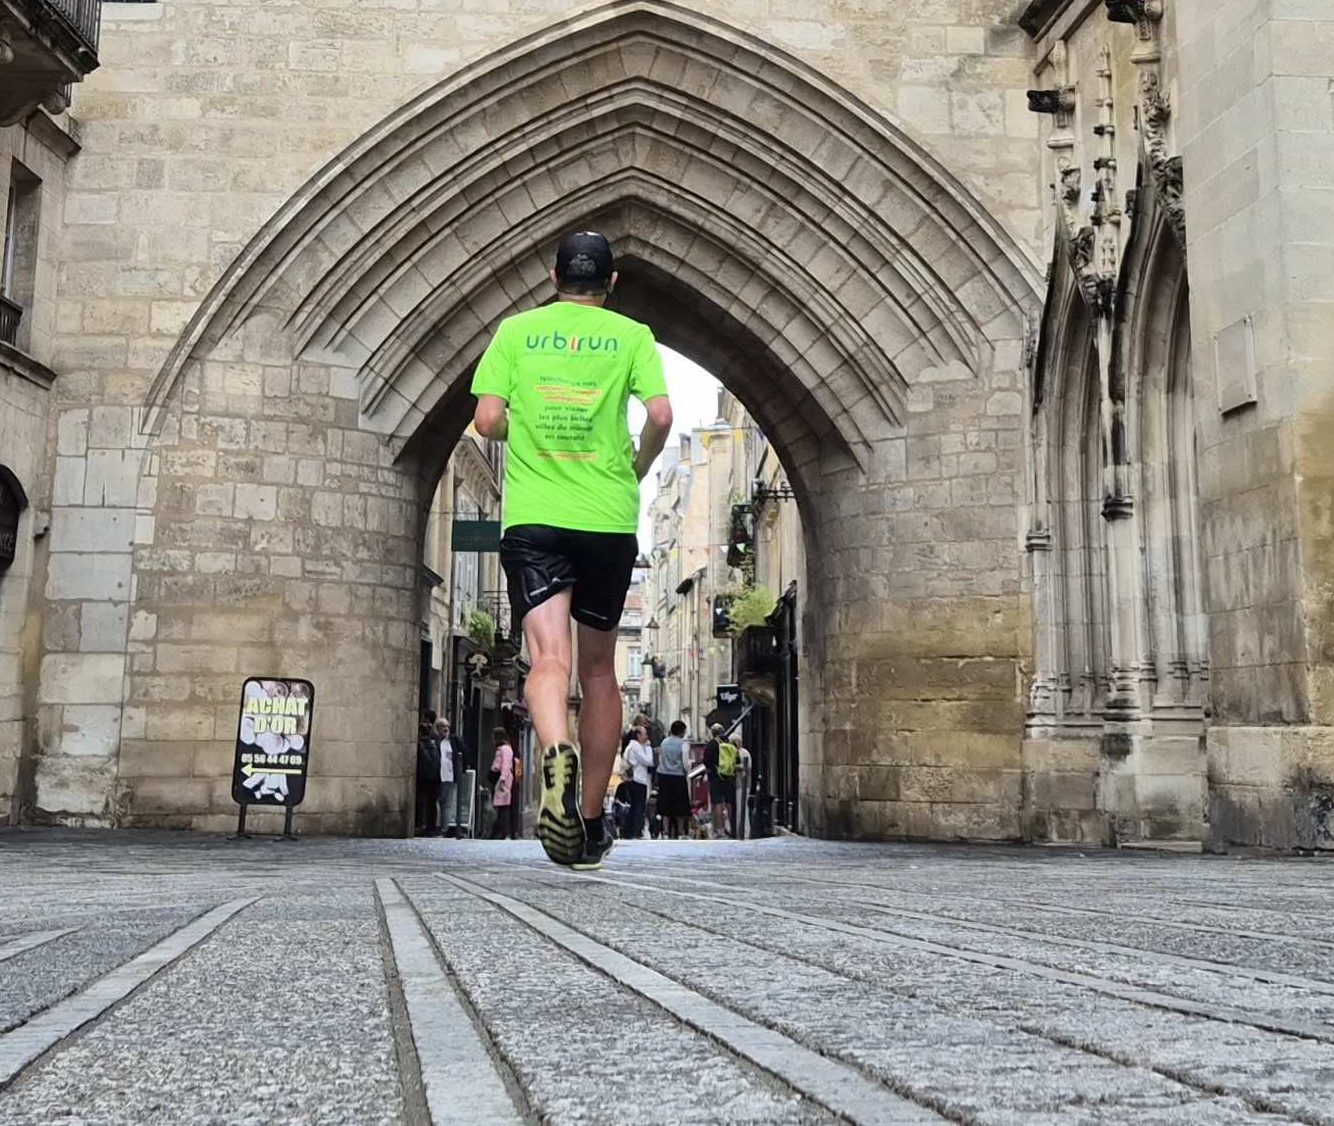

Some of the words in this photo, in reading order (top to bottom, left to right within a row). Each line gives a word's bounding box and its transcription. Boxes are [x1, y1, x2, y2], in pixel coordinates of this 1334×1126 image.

[526, 331, 618, 351] urbirun
[552, 414, 568, 422] plus
[248, 696, 309, 716] ACHAT
[253, 716, 299, 734] D'OR
[267, 754, 278, 764] 44
[279, 755, 289, 765] 47
